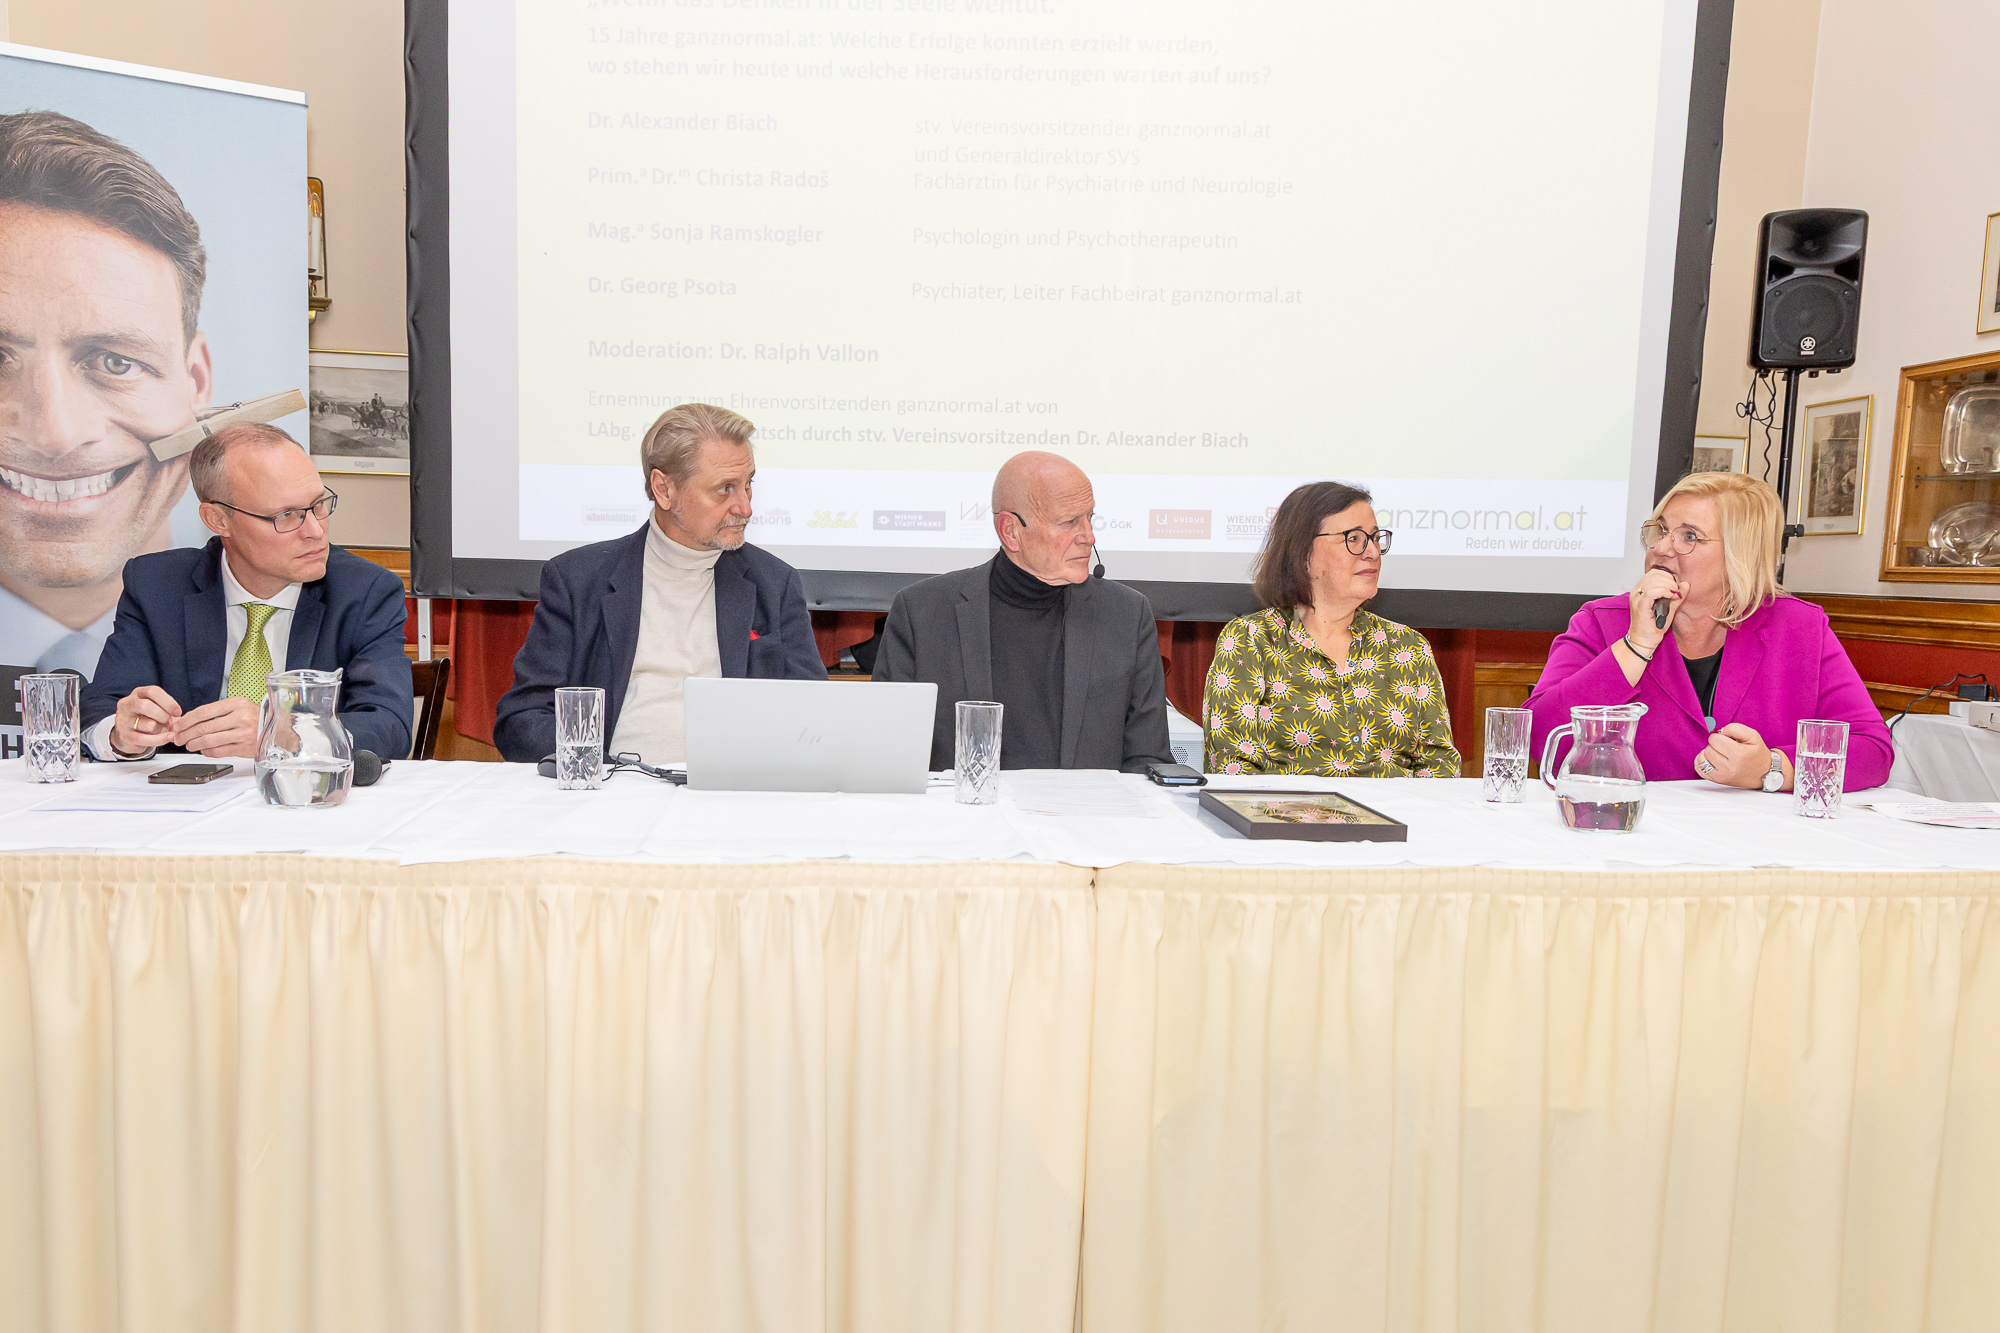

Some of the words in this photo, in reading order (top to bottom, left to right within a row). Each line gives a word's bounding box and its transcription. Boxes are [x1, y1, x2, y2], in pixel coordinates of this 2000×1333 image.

[588, 26, 611, 44] 15
[616, 25, 669, 45] Jahre
[674, 29, 823, 50] ganznormal.at:
[829, 30, 902, 50] Welche
[908, 31, 977, 55] Erfolge
[982, 32, 1064, 52] konnten
[1069, 33, 1132, 53] erzielt
[1137, 34, 1219, 57] werden,
[587, 60, 618, 75] wo
[623, 56, 689, 76] stehen
[694, 57, 727, 76] wir
[732, 58, 790, 78] heute
[795, 59, 833, 79] und
[839, 60, 909, 80] welche
[915, 62, 1106, 87] Herausforderungen
[1111, 67, 1182, 84] warten
[1188, 65, 1221, 85] auf
[1226, 65, 1272, 86] uns?
[587, 111, 614, 129] Dr.
[619, 110, 720, 131] Alexander
[725, 113, 778, 132] Biach
[914, 117, 944, 134] stv.
[950, 117, 1131, 138] Vereinsvorsitzender
[1138, 120, 1272, 142] ganznormal.at
[914, 144, 950, 163] und
[954, 145, 1102, 166] Generaldirektor
[1107, 148, 1141, 167] SVS
[696, 168, 764, 187] Christa
[769, 169, 830, 189] Radoš
[914, 172, 1008, 191] Fachärztin
[1013, 172, 1040, 191] für
[1045, 173, 1145, 196] Psychiatrie
[1150, 175, 1186, 194] und
[1191, 176, 1294, 199] Neurologie
[650, 222, 704, 245] Sonja
[709, 223, 824, 247] Ramskogler
[912, 226, 1020, 250] Psychologin
[1025, 228, 1061, 247] und
[1066, 229, 1238, 253] Psychotherapeutin
[588, 276, 614, 294] Dr.
[619, 276, 679, 299] Georg
[683, 278, 737, 296] Psota
[911, 281, 1007, 303] Psychiater,
[1013, 283, 1066, 301] Leiter
[1070, 284, 1166, 303] Fachbeirat
[1170, 286, 1303, 307] ganznormal.at
[588, 339, 713, 360] Moderation:
[720, 342, 747, 360] Dr.
[754, 342, 811, 365] Ralph
[816, 343, 879, 363] Vallon
[589, 391, 682, 407] Ernennung
[731, 393, 892, 414] Ehrenvorsitzenden
[896, 396, 1022, 416] ganznormal.at
[1026, 402, 1059, 415] von
[588, 421, 636, 442] LAbg.
[754, 424, 796, 440] utsch
[801, 425, 852, 442] durch
[857, 427, 887, 443] stv.
[892, 427, 1071, 446] Vereinsvorsitzenden
[1076, 429, 1101, 446] Dr.
[1105, 430, 1197, 448] Alexander
[1201, 431, 1249, 449] Biach
[751, 514, 792, 526] ations
[1110, 518, 1133, 529] ÖGK
[1173, 516, 1205, 524] UNIQUE
[1226, 515, 1264, 524] WIENER
[1226, 523, 1269, 533] STÄDTISC
[1376, 505, 1587, 531] anznormal.at
[1465, 536, 1506, 549] Reden
[1509, 536, 1529, 549] wir
[1532, 537, 1584, 550] darüber.
